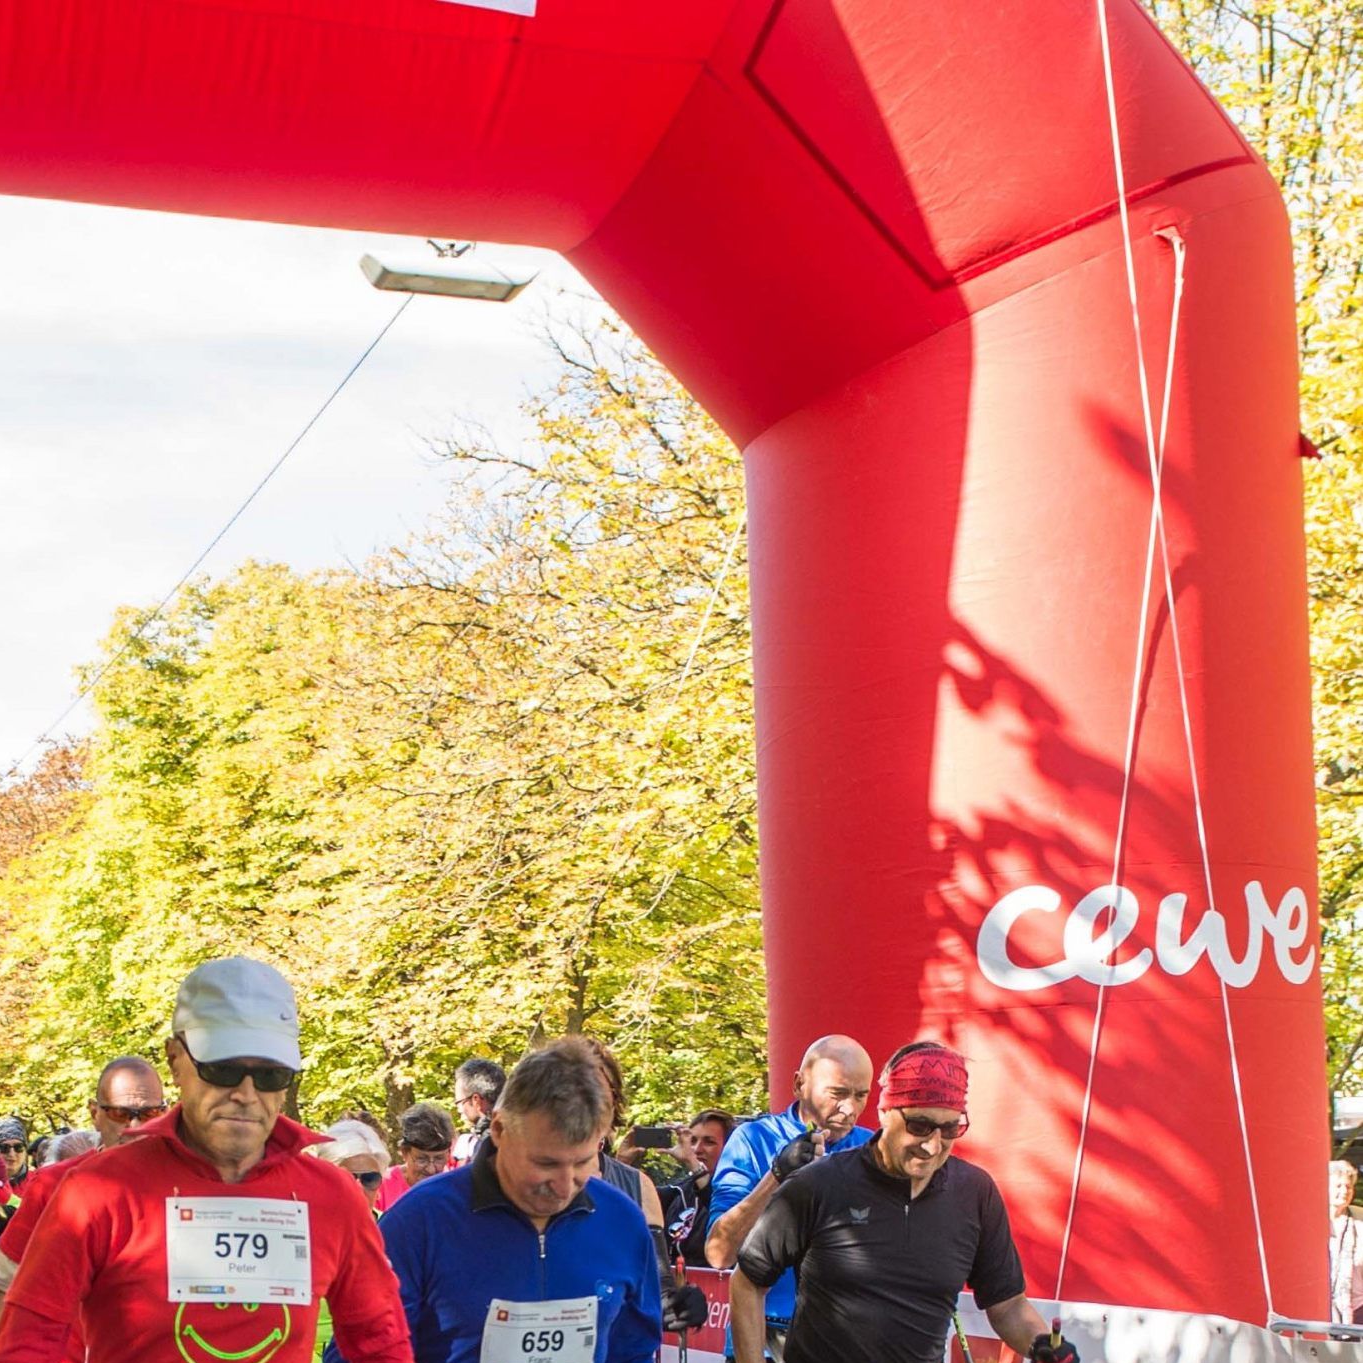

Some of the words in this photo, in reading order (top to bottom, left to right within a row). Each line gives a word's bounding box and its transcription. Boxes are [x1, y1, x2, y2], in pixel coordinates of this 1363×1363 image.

[977, 880, 1315, 991] cewe
[215, 1233, 268, 1259] 579
[228, 1263, 257, 1273] Peter
[703, 1292, 731, 1329] ien
[521, 1330, 565, 1353] 659
